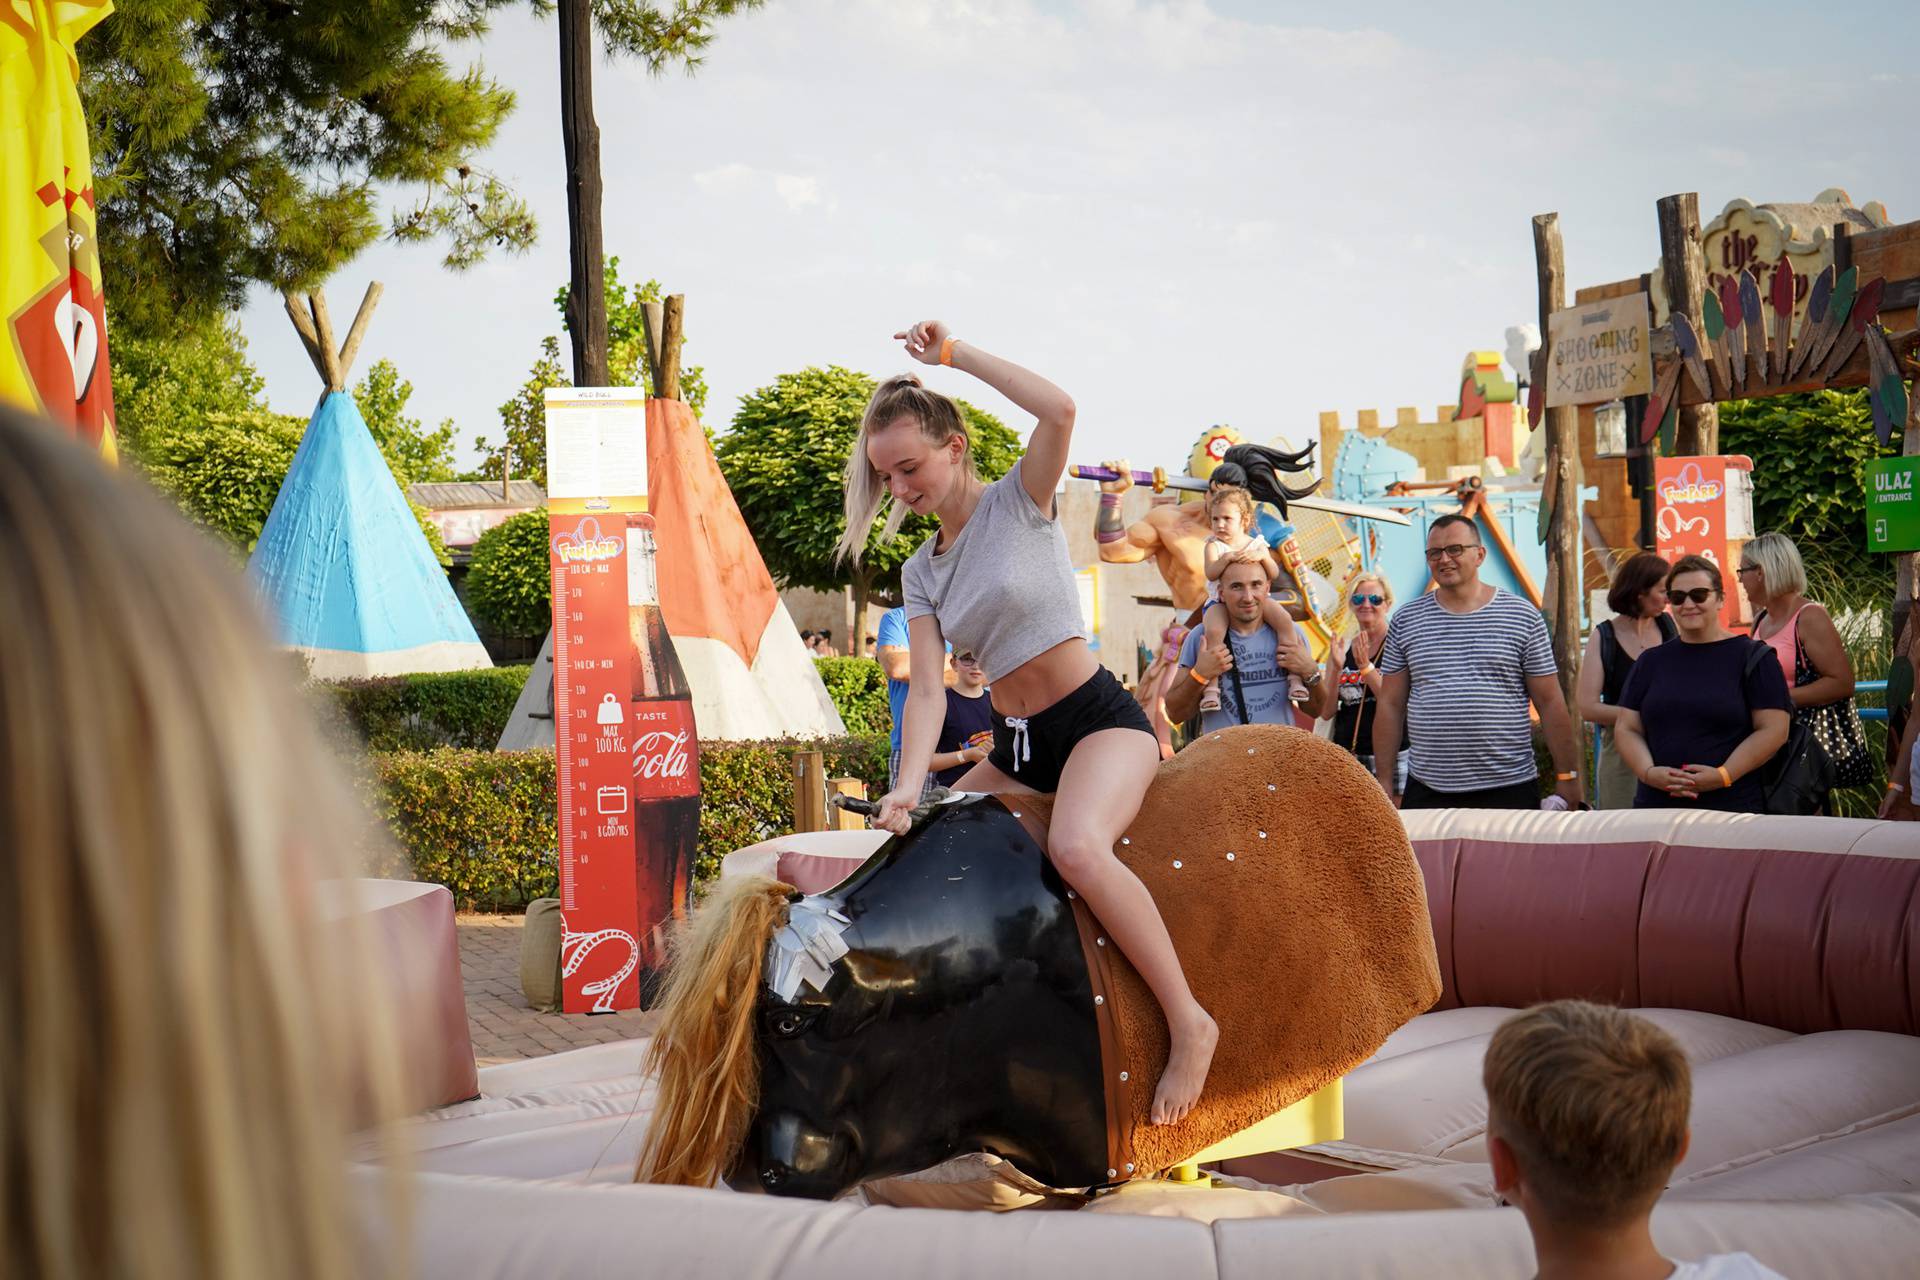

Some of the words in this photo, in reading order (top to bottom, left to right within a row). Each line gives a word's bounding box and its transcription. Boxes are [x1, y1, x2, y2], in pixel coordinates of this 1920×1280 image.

[1722, 229, 1759, 274] the
[1556, 326, 1640, 366] SHOOTING
[1574, 361, 1619, 393] ZONE
[1874, 470, 1913, 492] ULAZ
[585, 659, 595, 669] CM
[635, 712, 667, 721] TASTE
[603, 725, 619, 738] MAX
[595, 738, 612, 754] 100
[613, 736, 627, 753] KG
